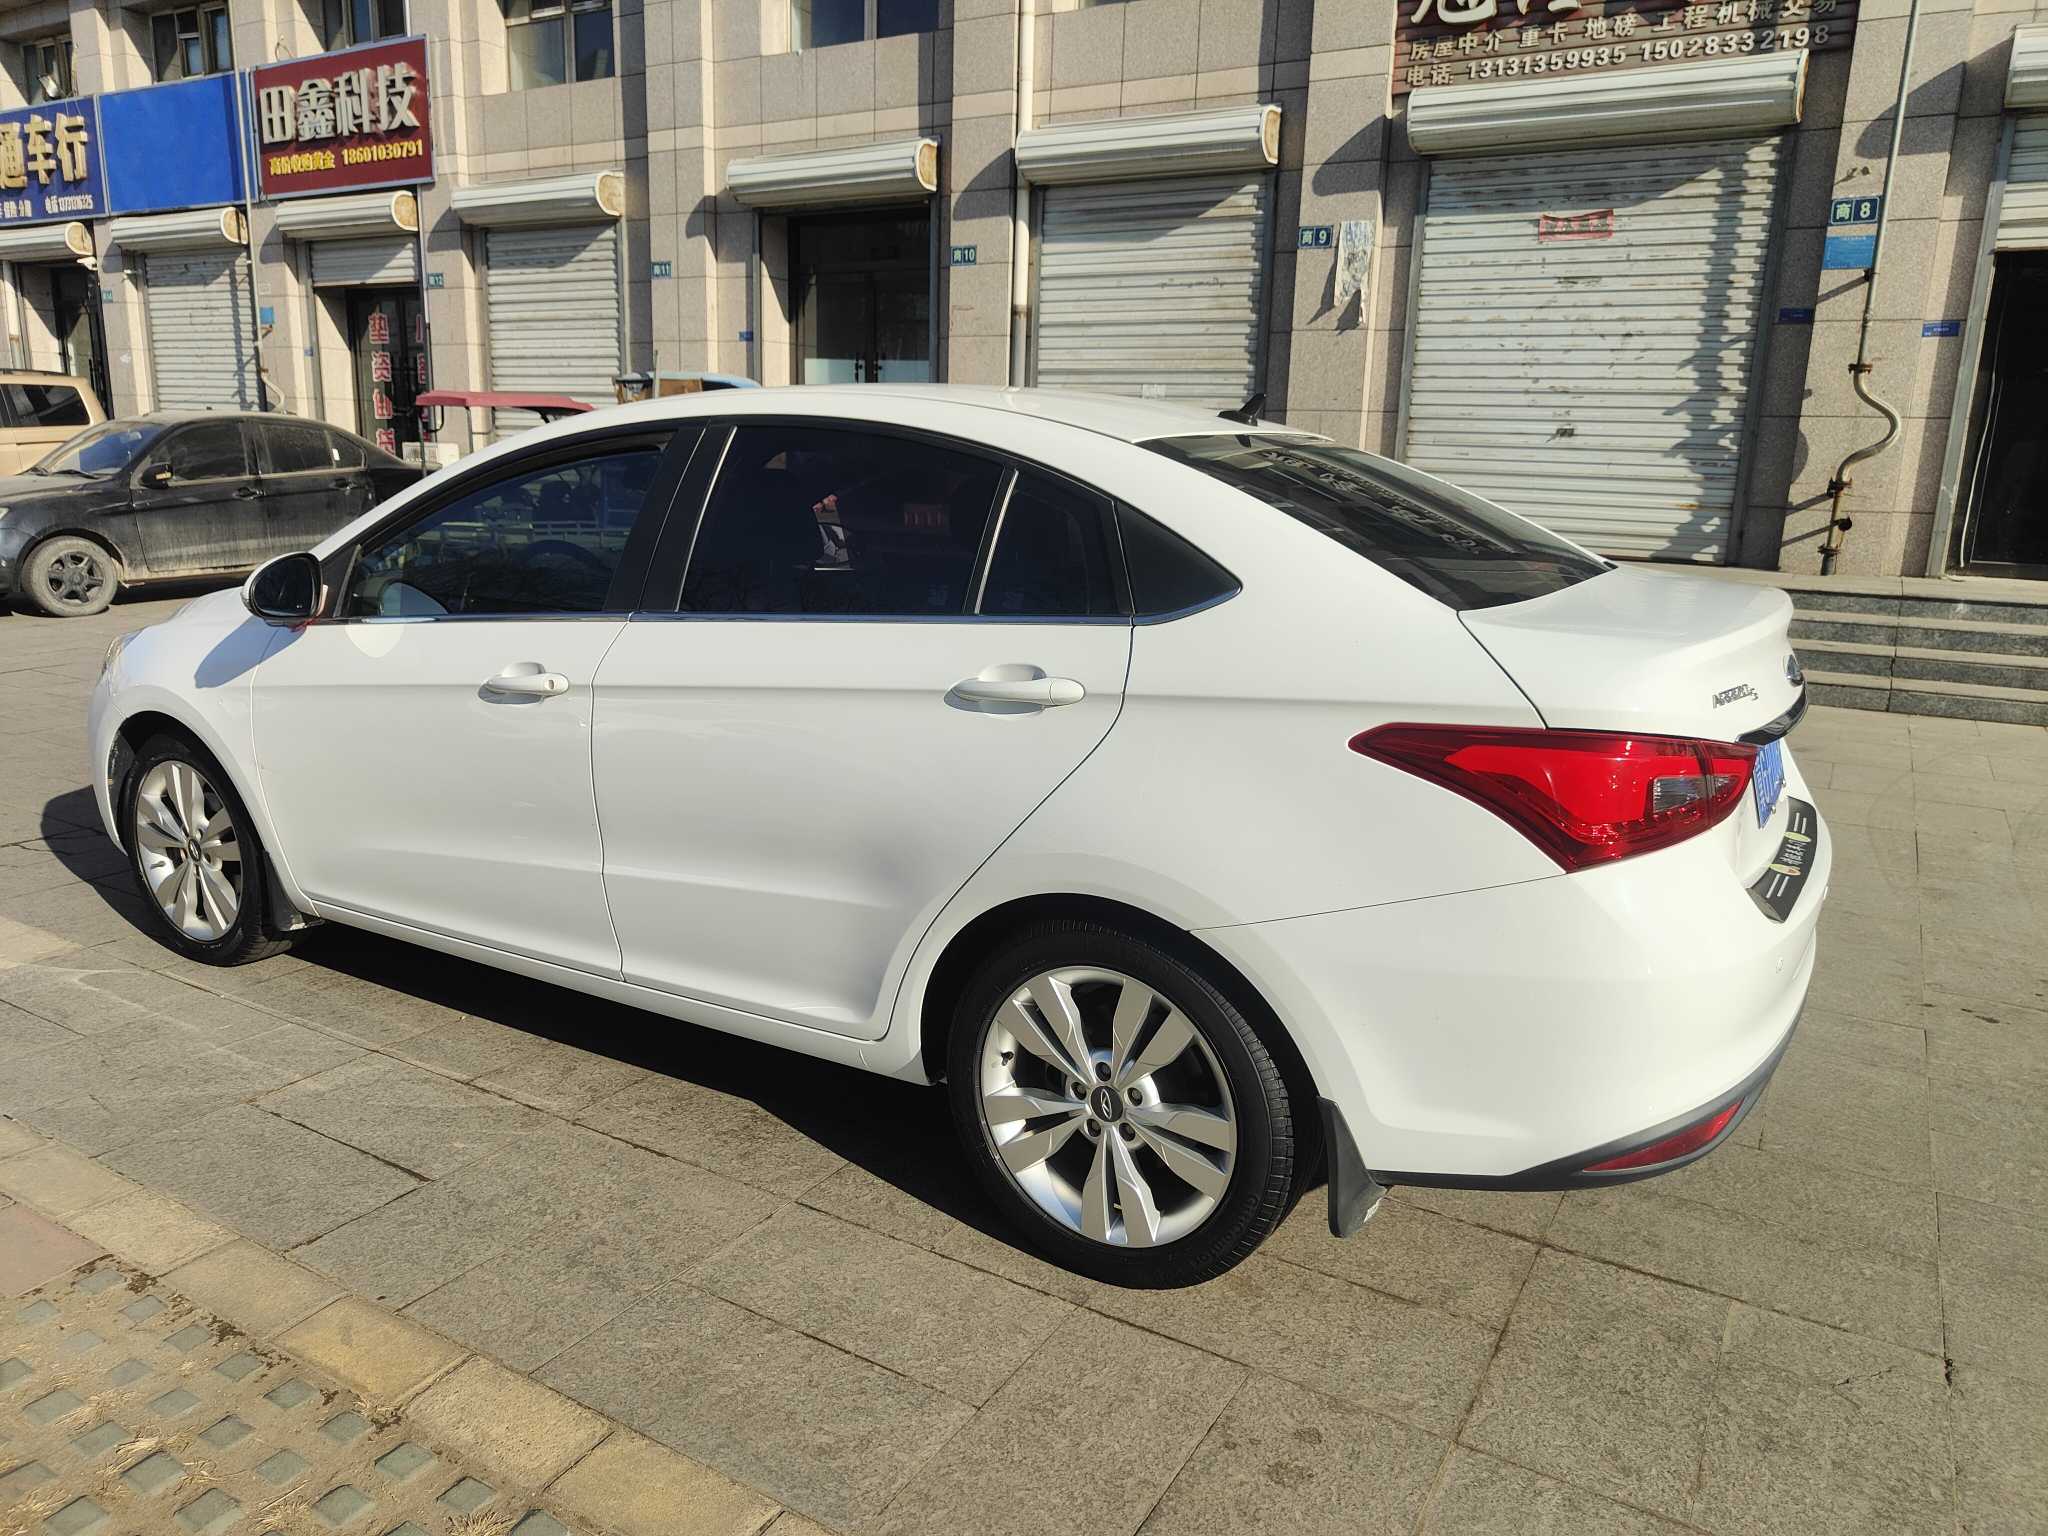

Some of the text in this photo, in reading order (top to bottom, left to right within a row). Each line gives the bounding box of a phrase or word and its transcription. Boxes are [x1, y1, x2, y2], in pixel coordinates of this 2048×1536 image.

[1410, 28, 1504, 60] 房屋中介
[1519, 21, 1568, 48] 重卡
[1585, 13, 1638, 39] 地磅
[1466, 46, 1627, 78] 13131359935
[1641, 25, 1829, 61] 15028332198
[260, 63, 421, 144] 田鑫科技
[341, 139, 423, 165] 18601030791
